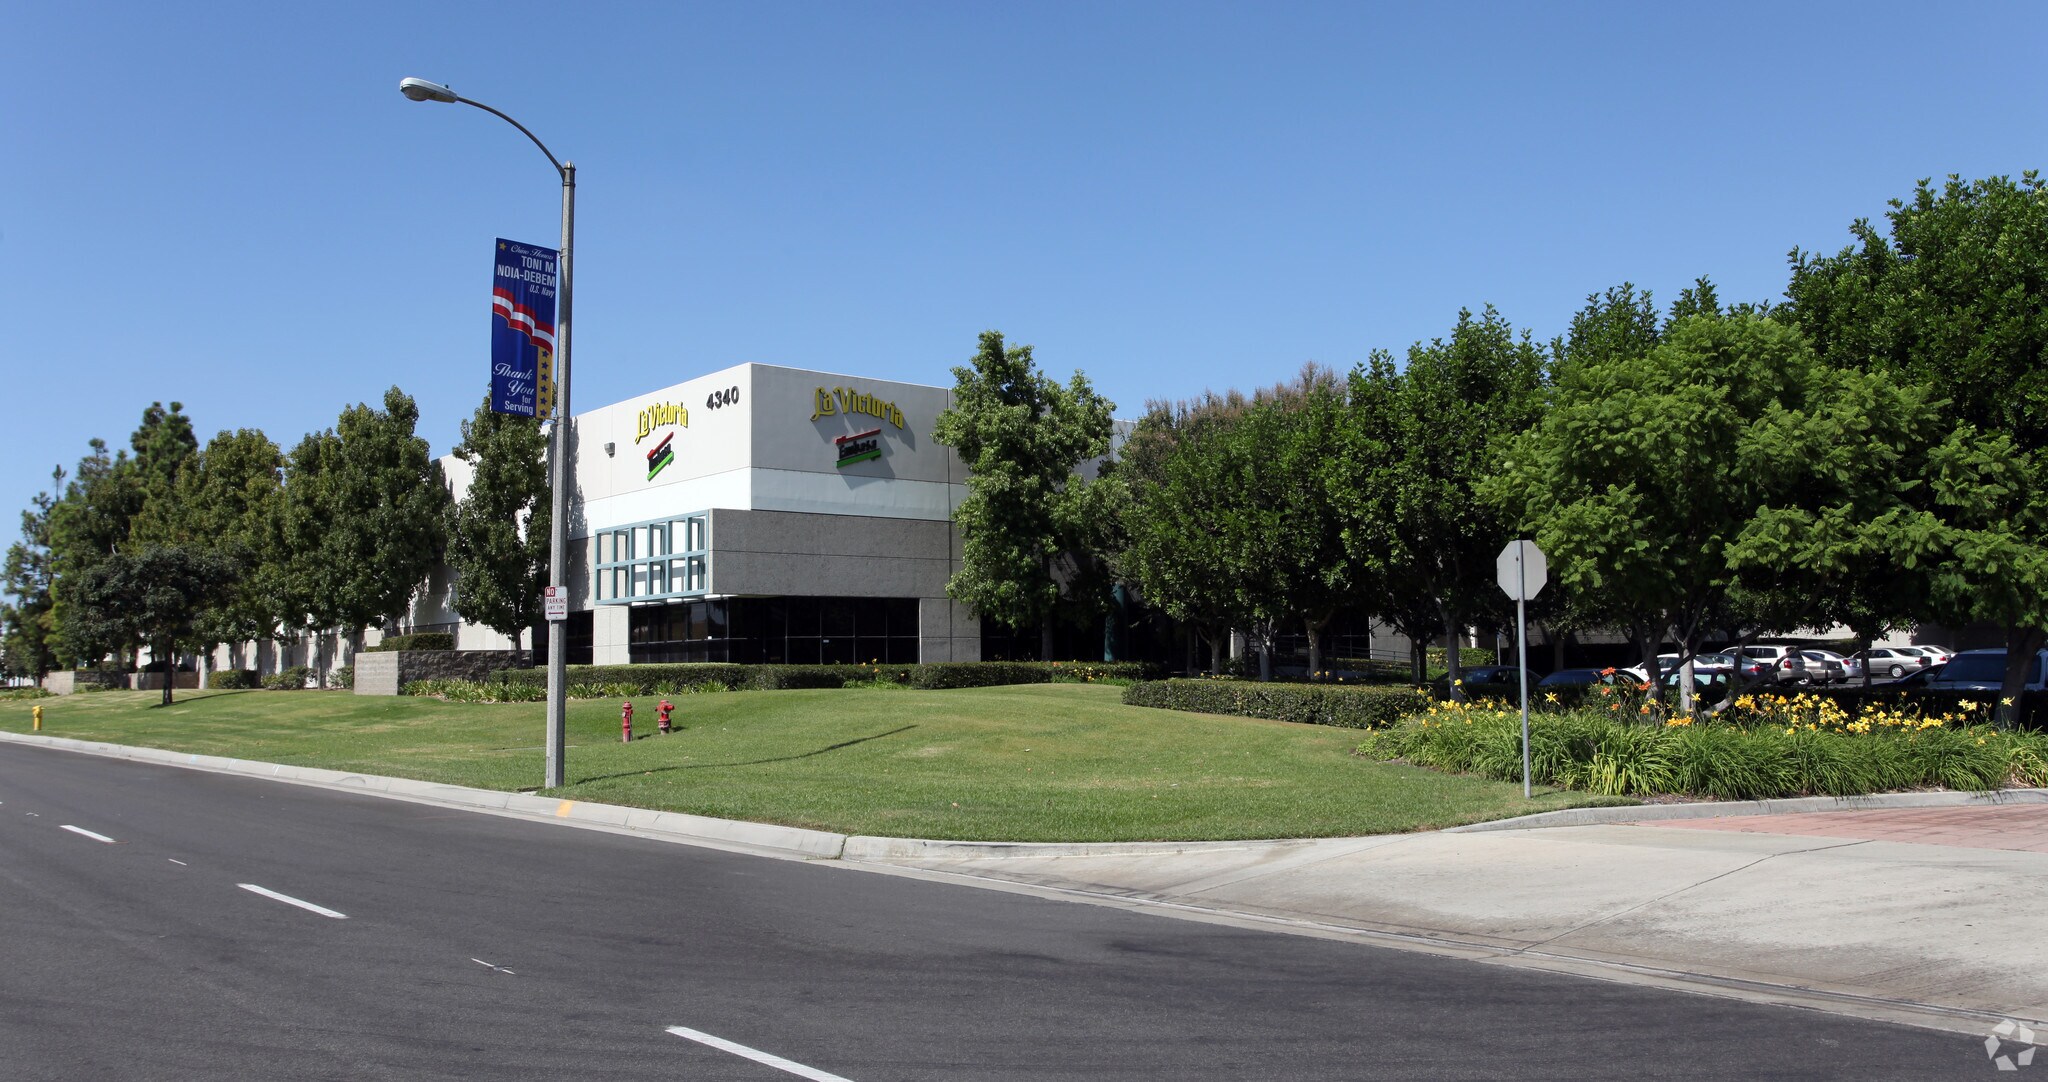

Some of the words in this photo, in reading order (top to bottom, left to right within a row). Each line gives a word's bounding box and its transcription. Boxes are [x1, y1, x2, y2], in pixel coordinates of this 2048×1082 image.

[521, 255, 542, 271] TONI
[545, 261, 556, 274] M.
[529, 284, 540, 294] U.S.
[541, 287, 555, 299] Navy
[492, 362, 533, 380] Thank
[506, 379, 535, 397] You
[521, 395, 532, 405] for
[706, 385, 740, 411] 4340
[504, 400, 534, 416] Serving
[809, 386, 837, 422] La
[833, 386, 905, 430] Victoria
[634, 409, 651, 445] La
[647, 401, 689, 430] Victoria
[547, 588, 555, 596] NO
